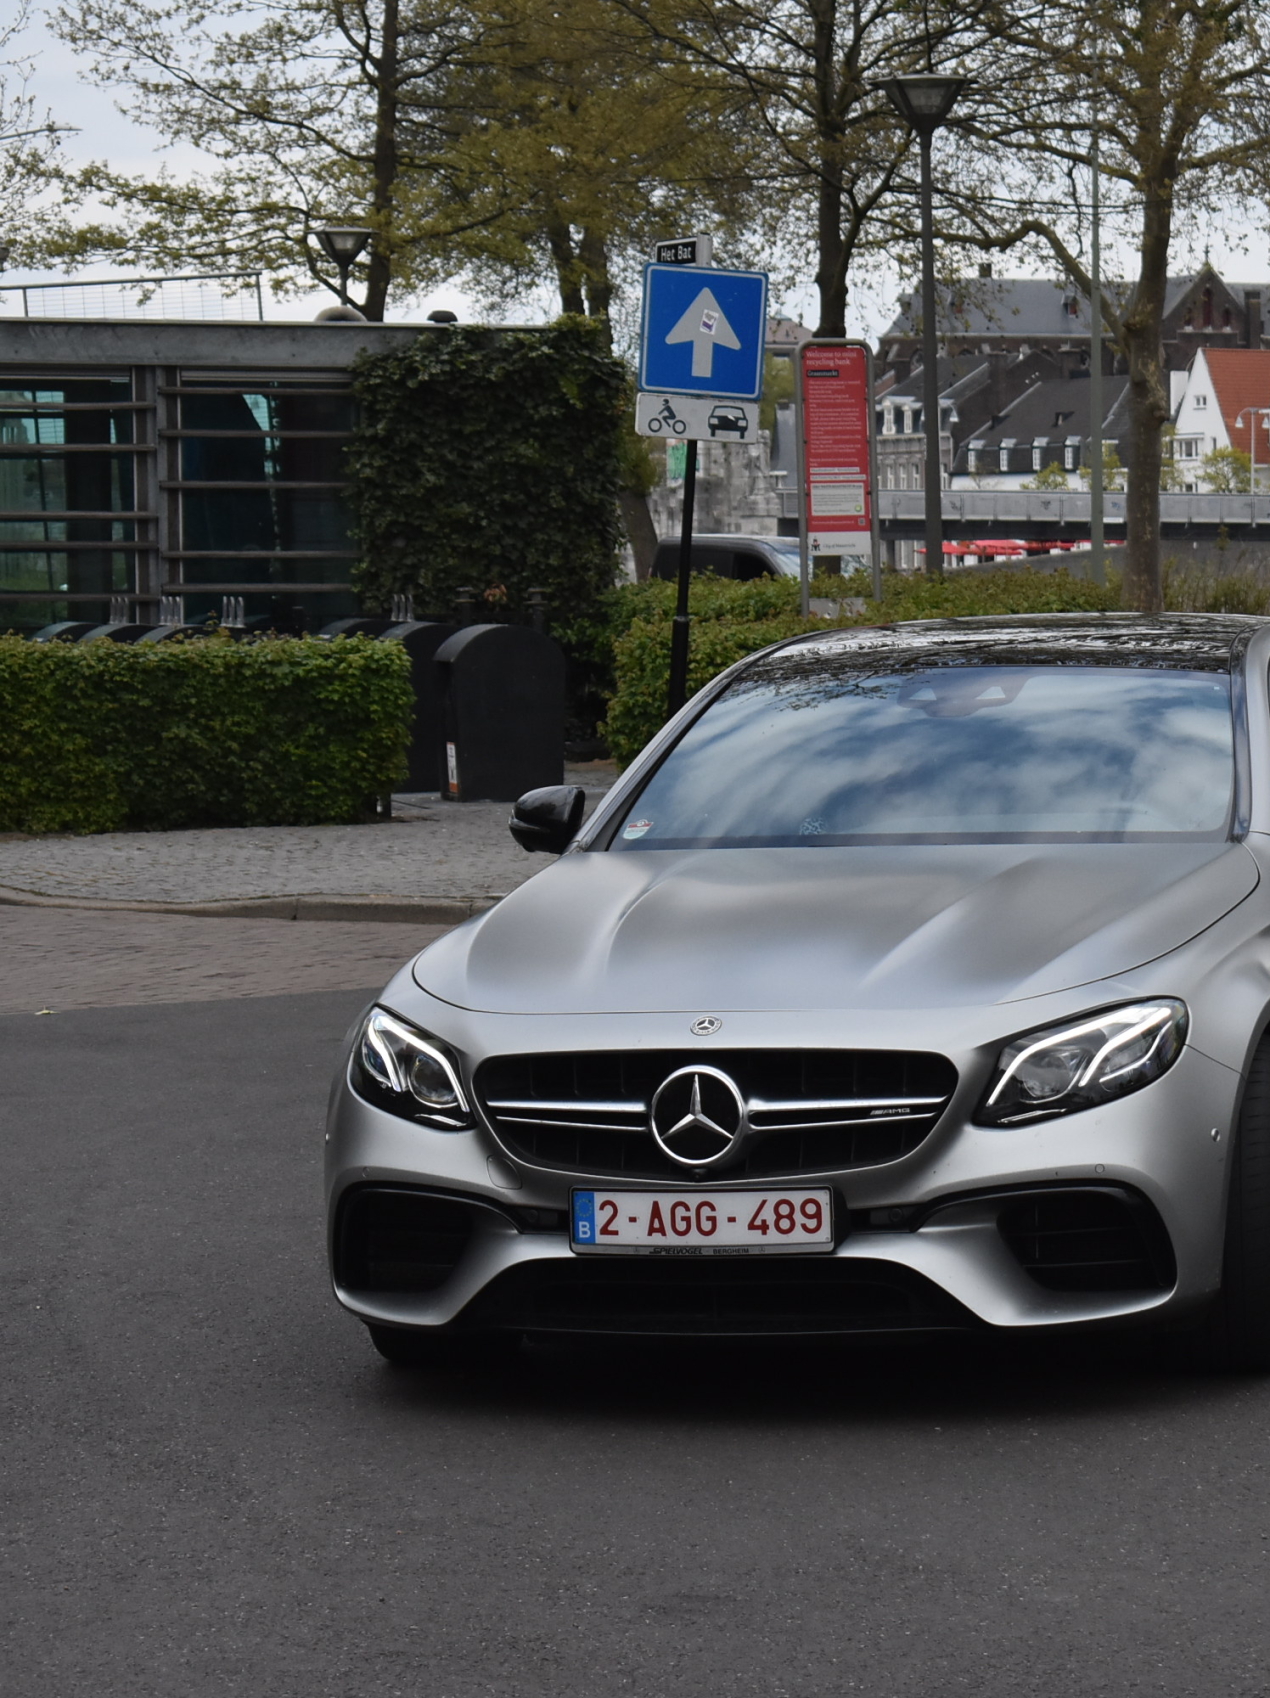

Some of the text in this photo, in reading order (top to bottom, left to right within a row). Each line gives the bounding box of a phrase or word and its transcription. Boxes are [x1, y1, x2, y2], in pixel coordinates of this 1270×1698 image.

[661, 245, 692, 261] Het Bat
[806, 350, 833, 358] Welcome
[806, 358, 851, 367] recycling bank
[881, 1107, 910, 1115] AMG
[598, 1197, 823, 1237] 2-AGG-489
[578, 1221, 591, 1238] B
[648, 1247, 750, 1255] SPIELVOGEL BERGHEIM
